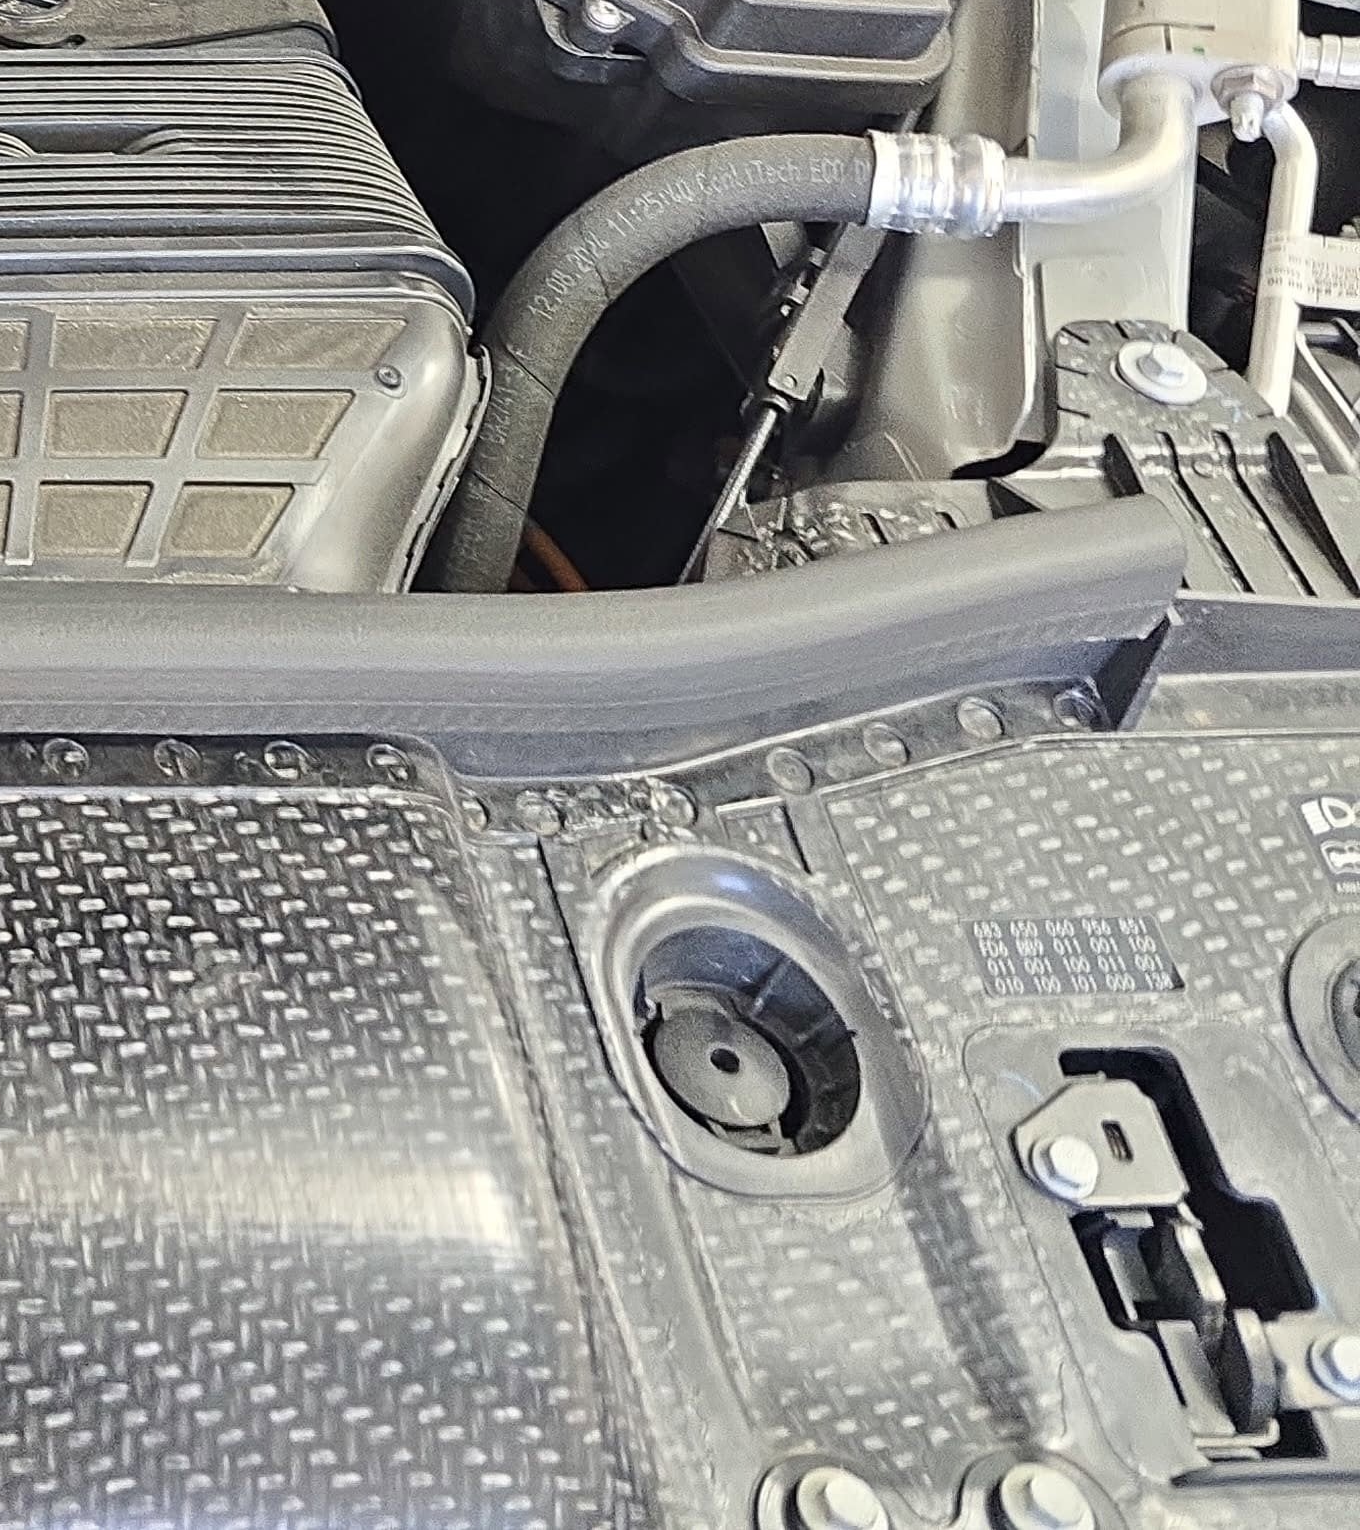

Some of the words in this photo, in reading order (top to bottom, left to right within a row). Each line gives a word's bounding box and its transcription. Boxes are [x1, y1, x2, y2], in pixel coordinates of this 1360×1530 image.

[1052, 937, 1082, 956] 011
[1089, 936, 1118, 954] 001
[987, 957, 1016, 976] 011
[1062, 955, 1091, 973] 100
[1098, 954, 1127, 972] 011
[1134, 953, 1164, 971] 001
[1033, 975, 1062, 993] 100
[1071, 973, 1099, 993] 101
[1105, 972, 1136, 991] 000
